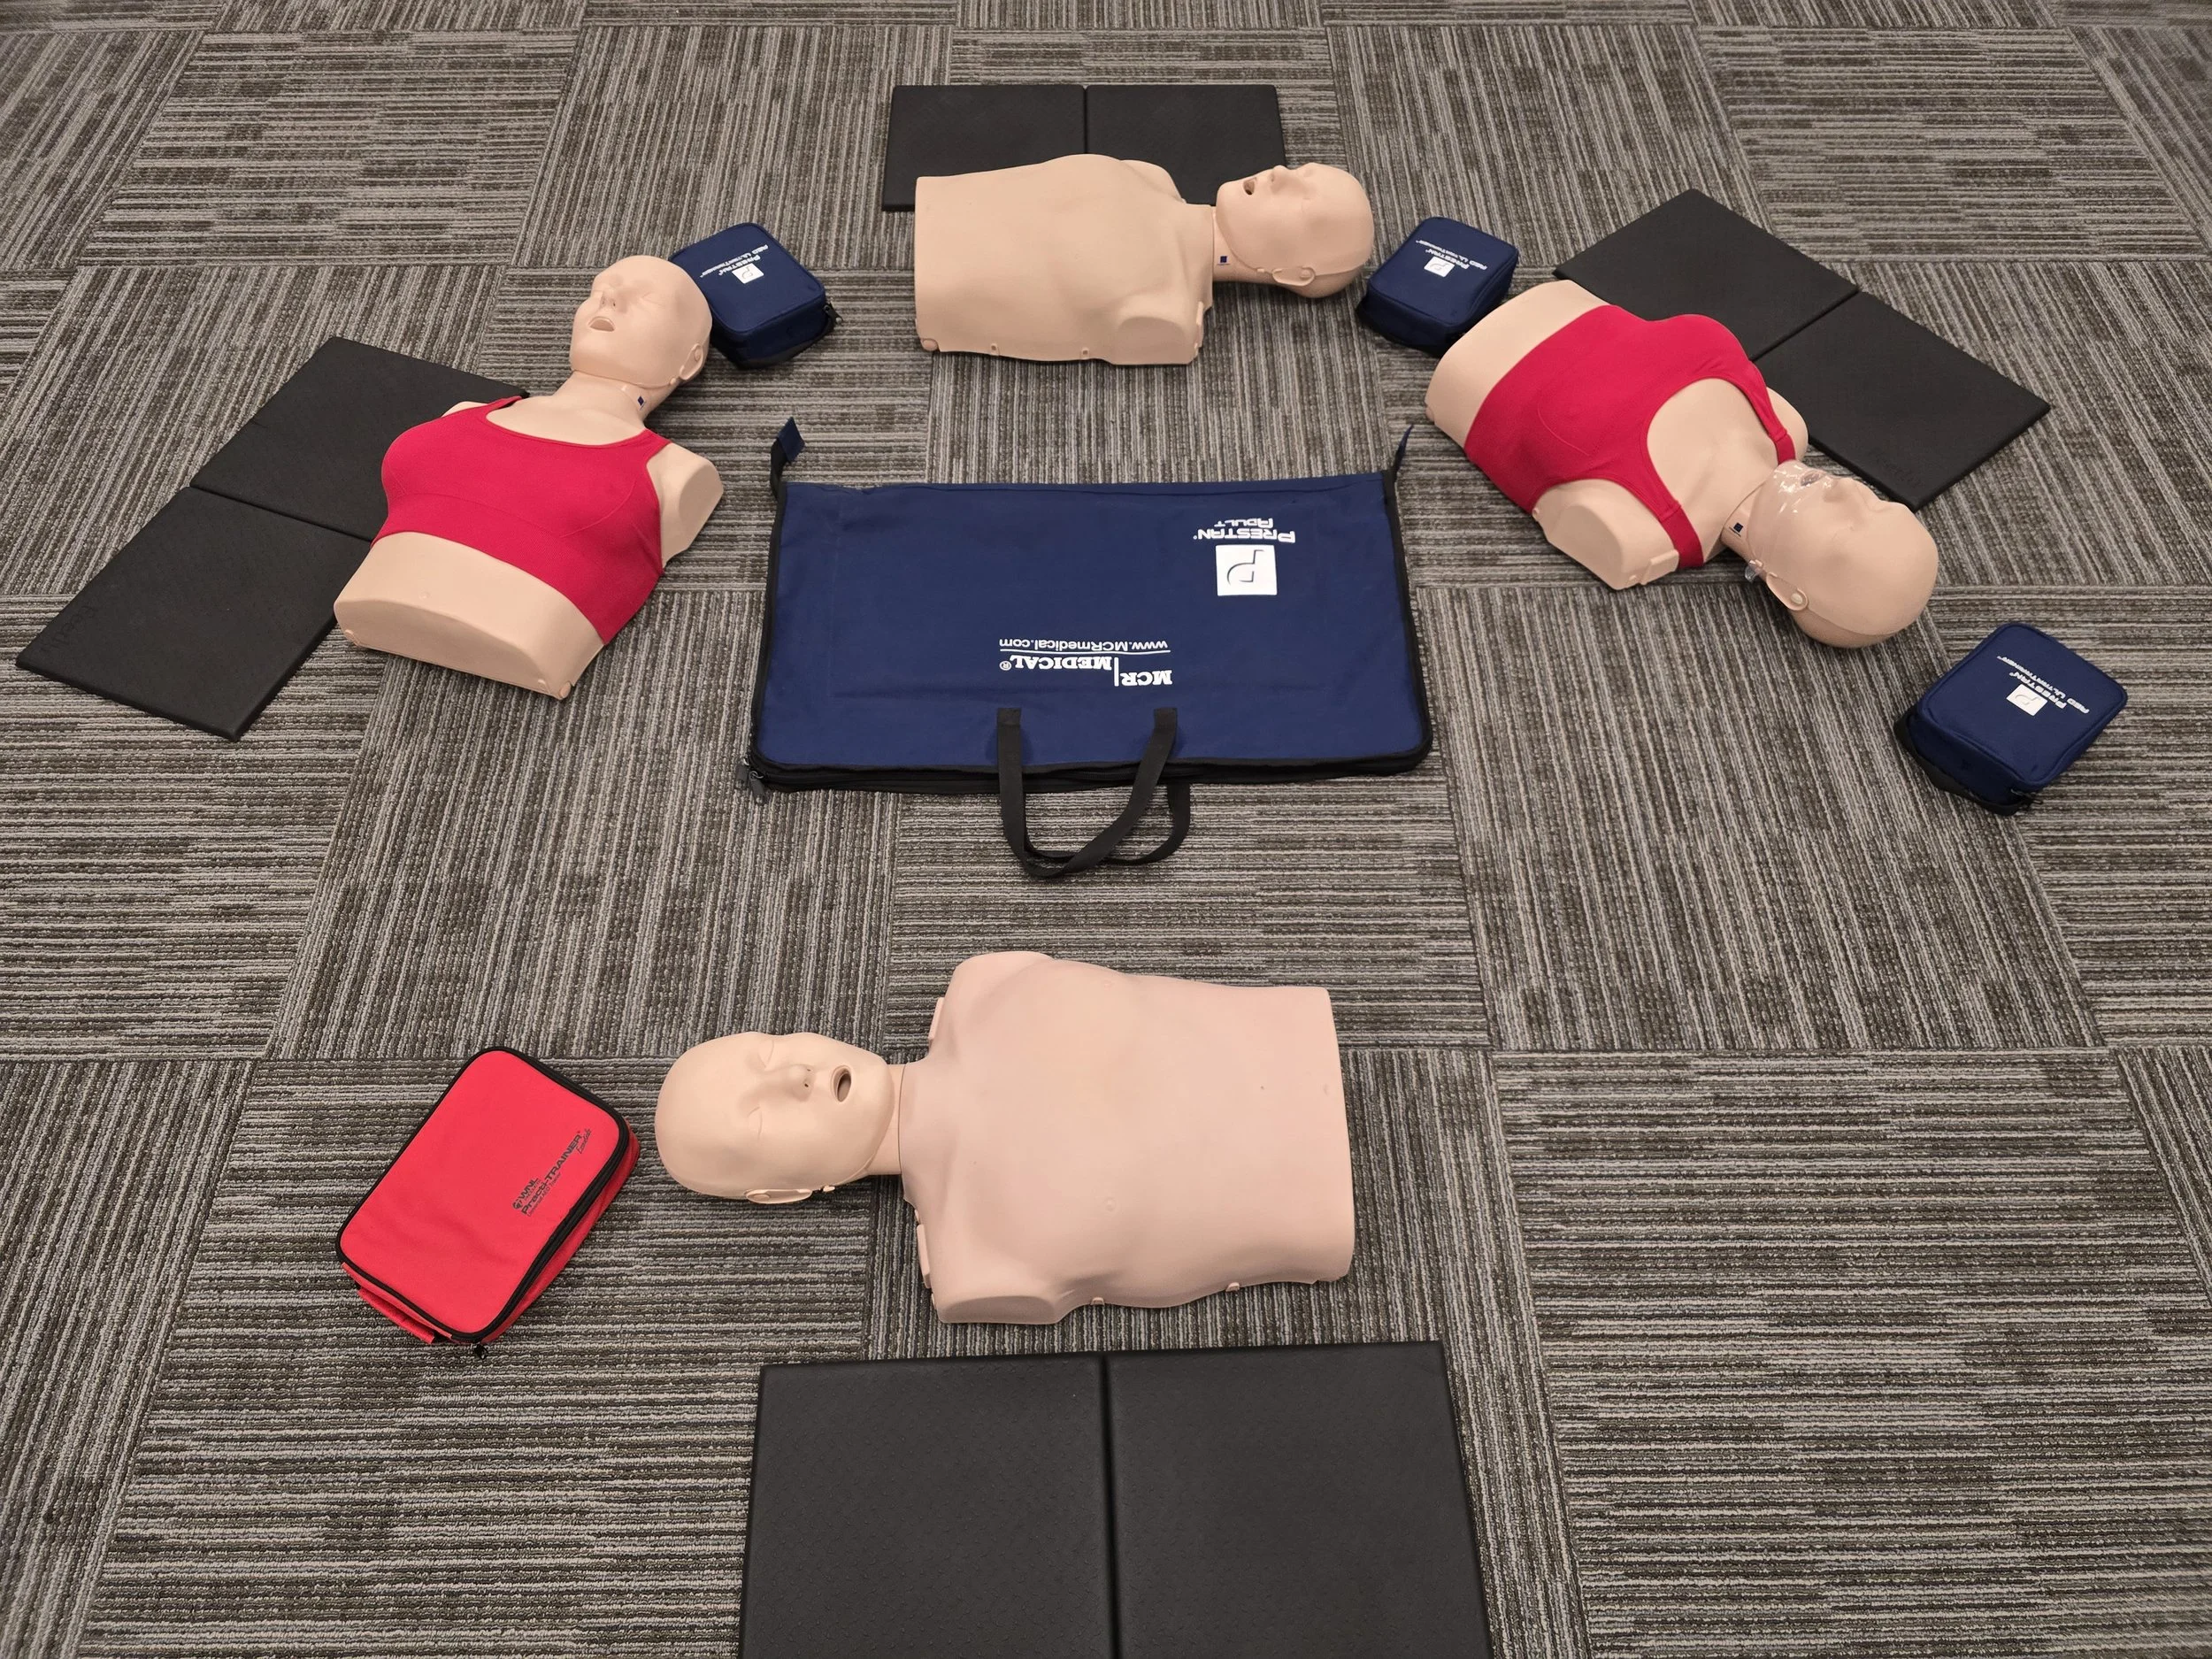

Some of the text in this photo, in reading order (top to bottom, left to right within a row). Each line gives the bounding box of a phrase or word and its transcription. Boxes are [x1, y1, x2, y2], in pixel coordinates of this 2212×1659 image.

[1214, 518, 1274, 528] ADULT
[999, 639, 1168, 652] www.MCRmedical.com
[1119, 670, 1172, 686] MCR
[518, 1178, 538, 1199] WNL
